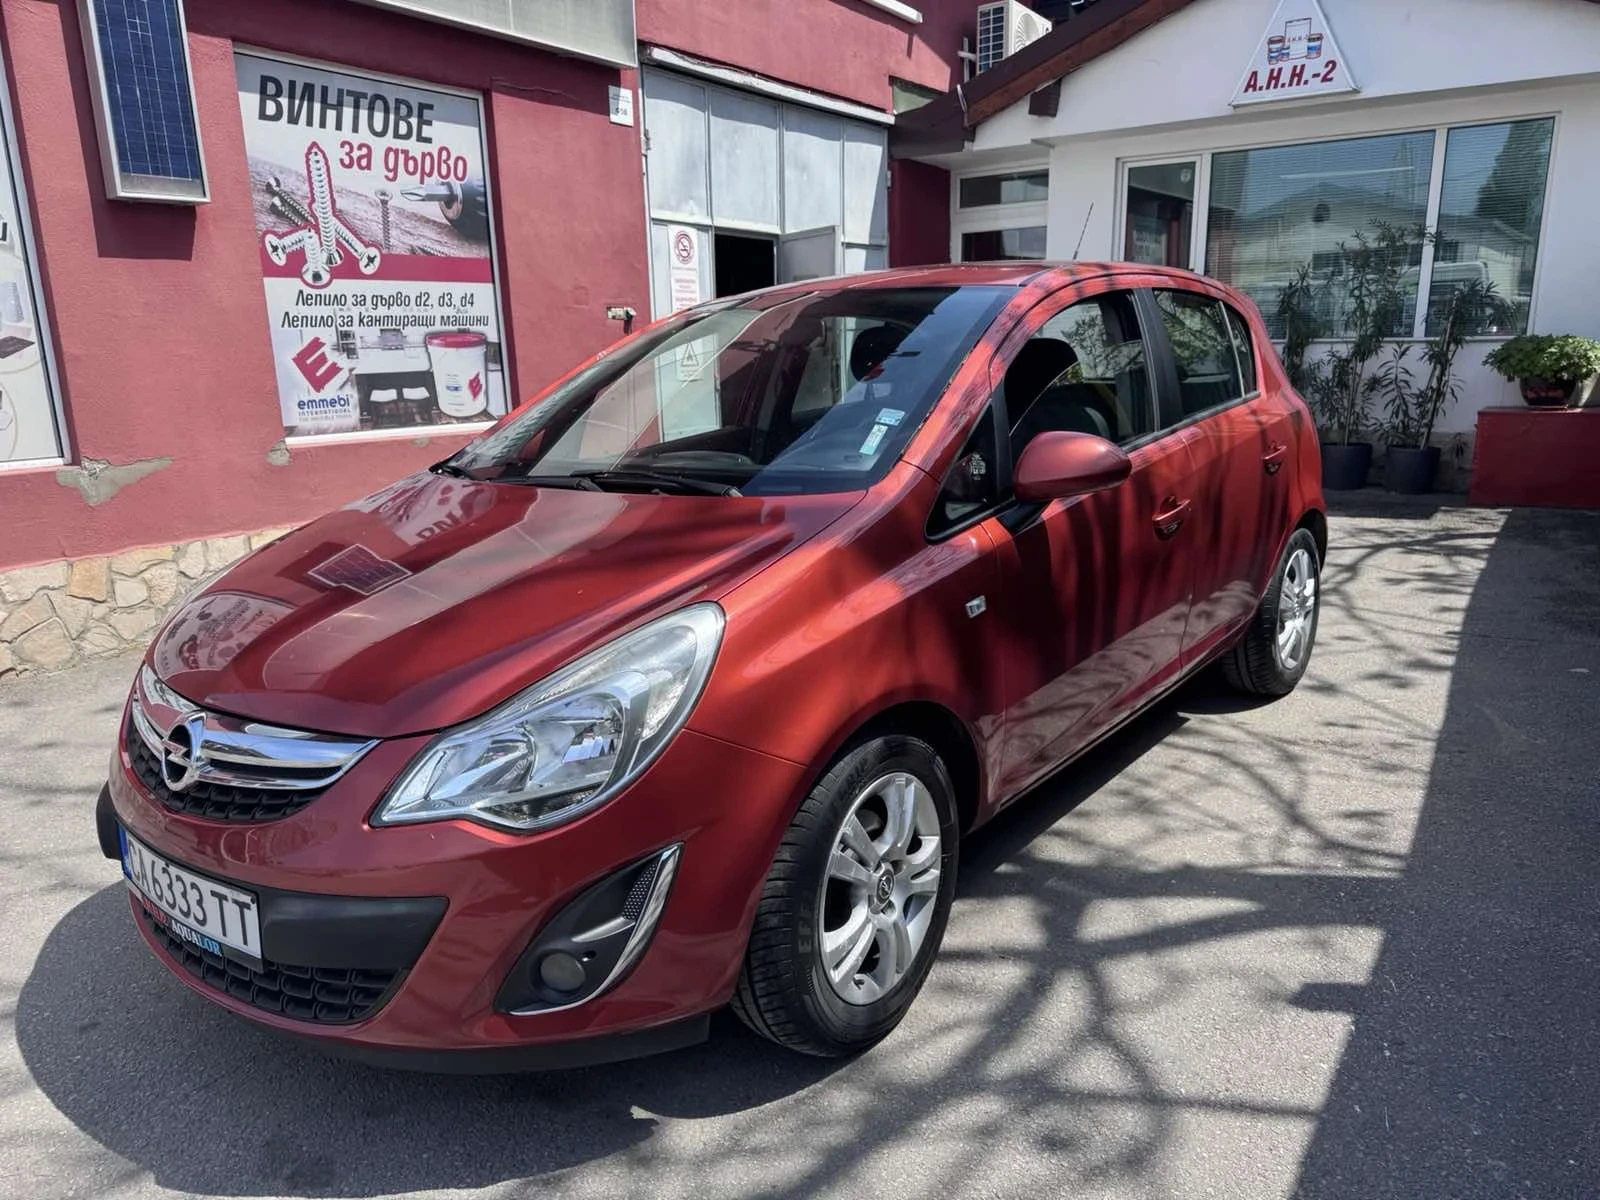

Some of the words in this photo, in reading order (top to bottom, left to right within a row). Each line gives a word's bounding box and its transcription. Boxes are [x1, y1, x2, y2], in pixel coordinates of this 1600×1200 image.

[258, 75, 434, 144] ВИНТОВЕ
[339, 140, 373, 171] за
[383, 145, 468, 184] дърво
[295, 289, 347, 307] Лепило
[351, 295, 367, 307] за
[371, 292, 411, 310] дърво
[415, 292, 433, 309] d2,
[438, 292, 456, 310] d3,
[460, 292, 475, 307] d4
[281, 312, 334, 328] Лепило
[338, 314, 354, 328] за
[358, 313, 436, 330] кантиращи
[440, 315, 489, 328] машини
[297, 394, 350, 409] emmebi
